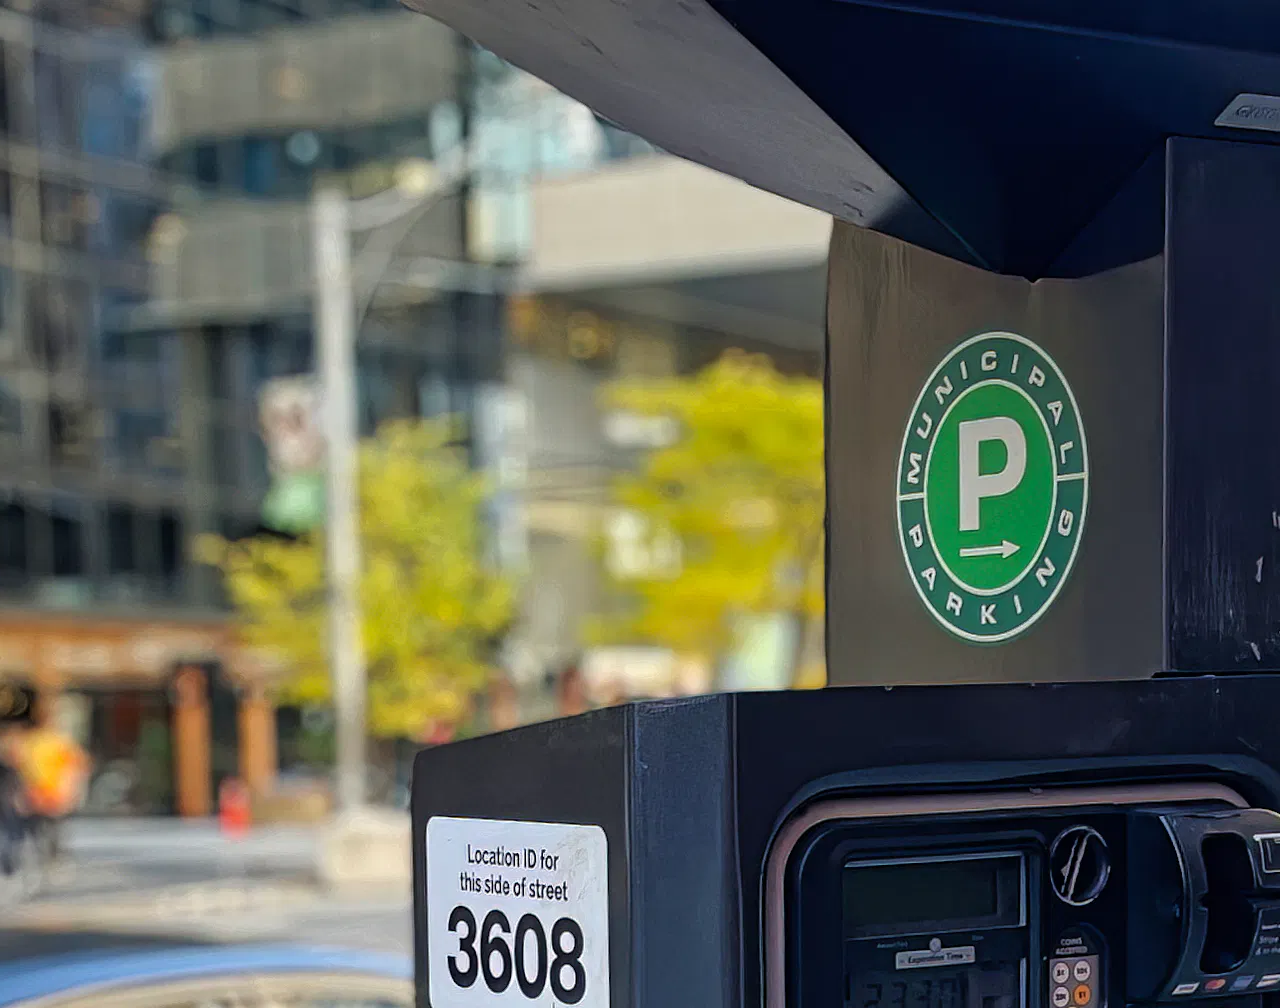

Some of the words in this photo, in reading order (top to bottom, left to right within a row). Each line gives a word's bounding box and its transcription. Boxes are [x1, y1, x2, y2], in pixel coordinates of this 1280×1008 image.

[907, 351, 1073, 484] MUNICIPAL
[959, 417, 1027, 531] P
[909, 510, 1073, 624] PARKING
[460, 872, 481, 893] this
[484, 874, 509, 895] side
[513, 877, 526, 897] of
[529, 879, 568, 901] street
[467, 844, 520, 867] Location
[524, 848, 536, 869] ID
[541, 850, 559, 871] for
[447, 905, 586, 1004] 3608
